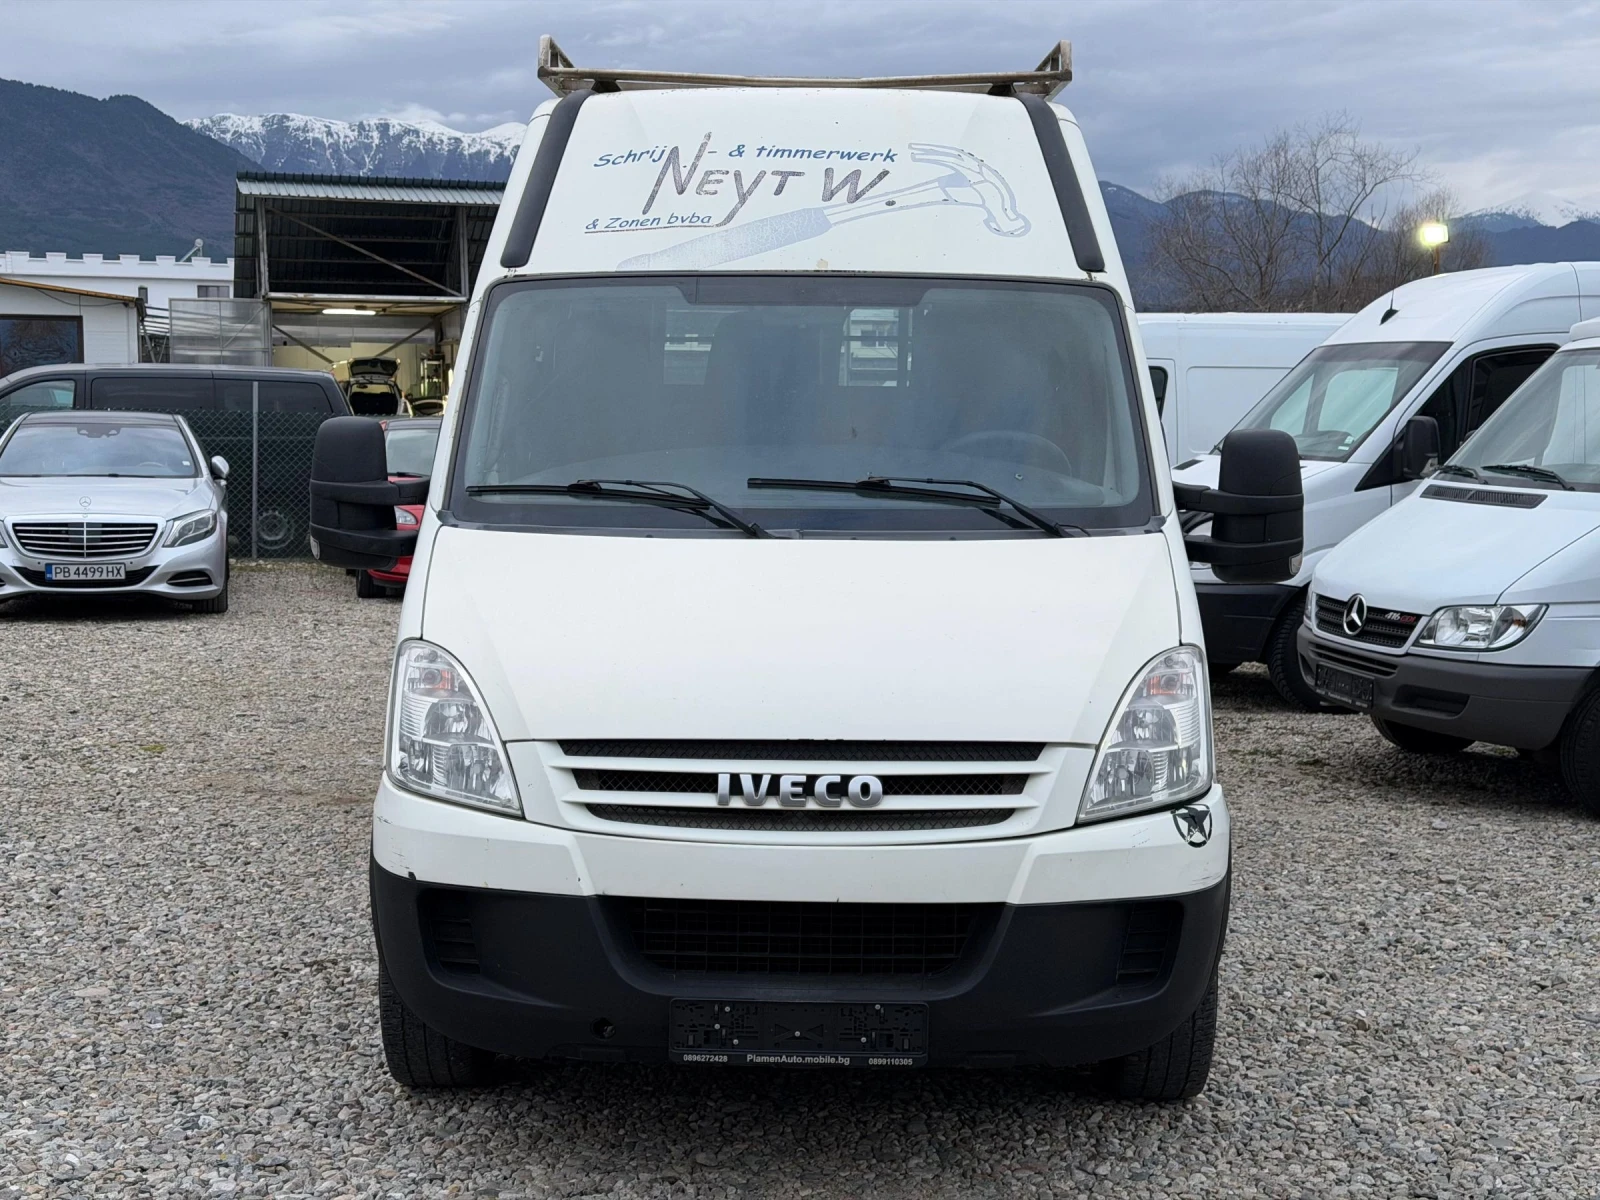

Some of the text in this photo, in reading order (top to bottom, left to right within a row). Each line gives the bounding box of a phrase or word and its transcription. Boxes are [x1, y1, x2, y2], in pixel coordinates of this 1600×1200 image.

[728, 144, 746, 159] &
[755, 144, 899, 163] timmerwerk
[585, 212, 713, 230] & Zonen bvba
[54, 566, 71, 578] PB
[73, 566, 104, 578] 4499
[106, 565, 123, 578] HX
[716, 773, 884, 808] IVECO
[746, 1053, 851, 1066] PlamenAuto.mobile.bg
